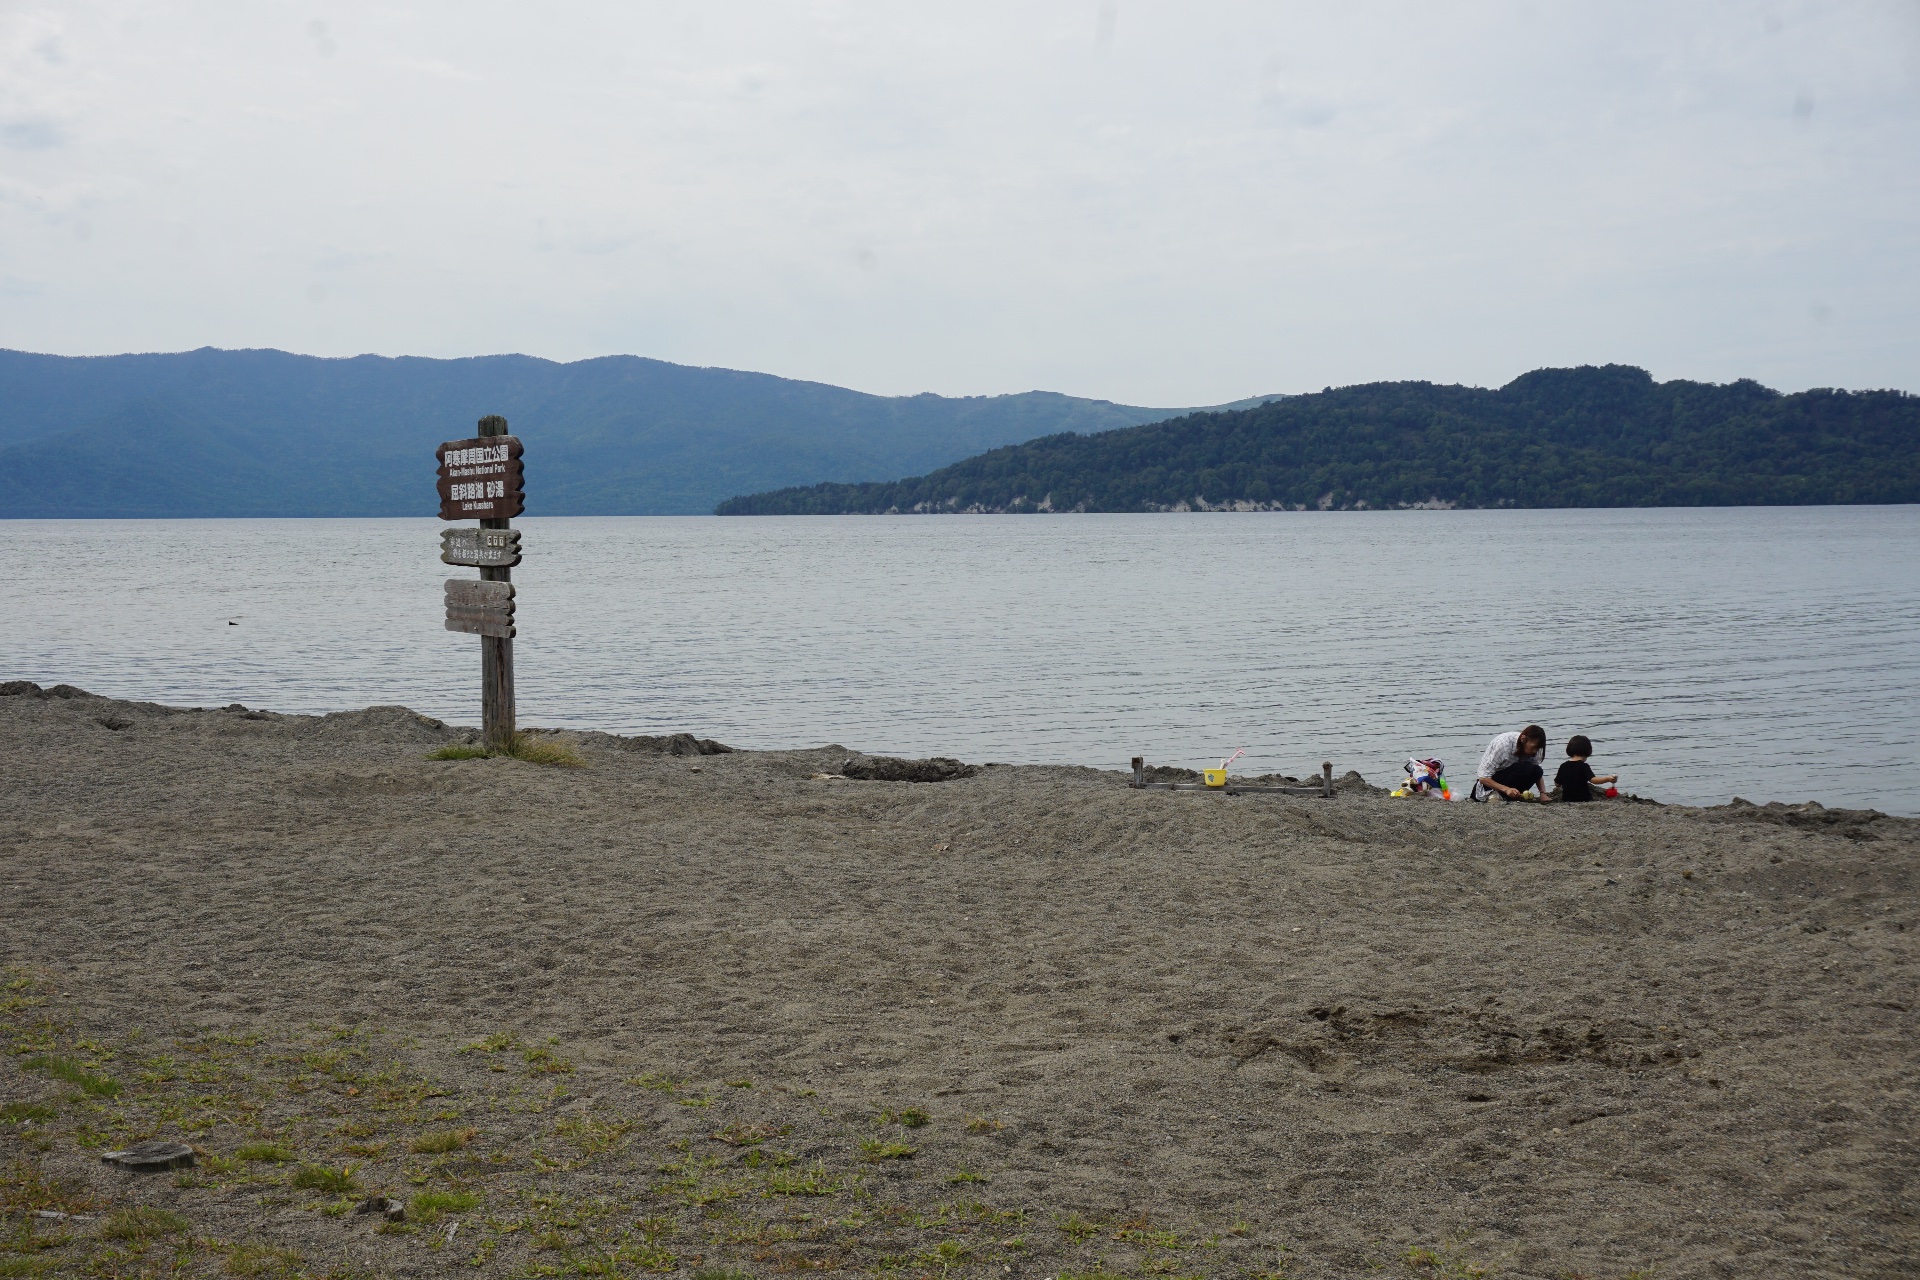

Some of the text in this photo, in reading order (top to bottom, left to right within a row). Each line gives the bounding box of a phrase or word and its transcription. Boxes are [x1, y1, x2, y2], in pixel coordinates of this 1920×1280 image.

[445, 445, 509, 467] 阿寒摩周国立公園
[475, 464, 494, 475] National
[494, 463, 506, 473] Park
[451, 480, 504, 501] 屈斜路湖 砂湯
[462, 502, 473, 511] Lake
